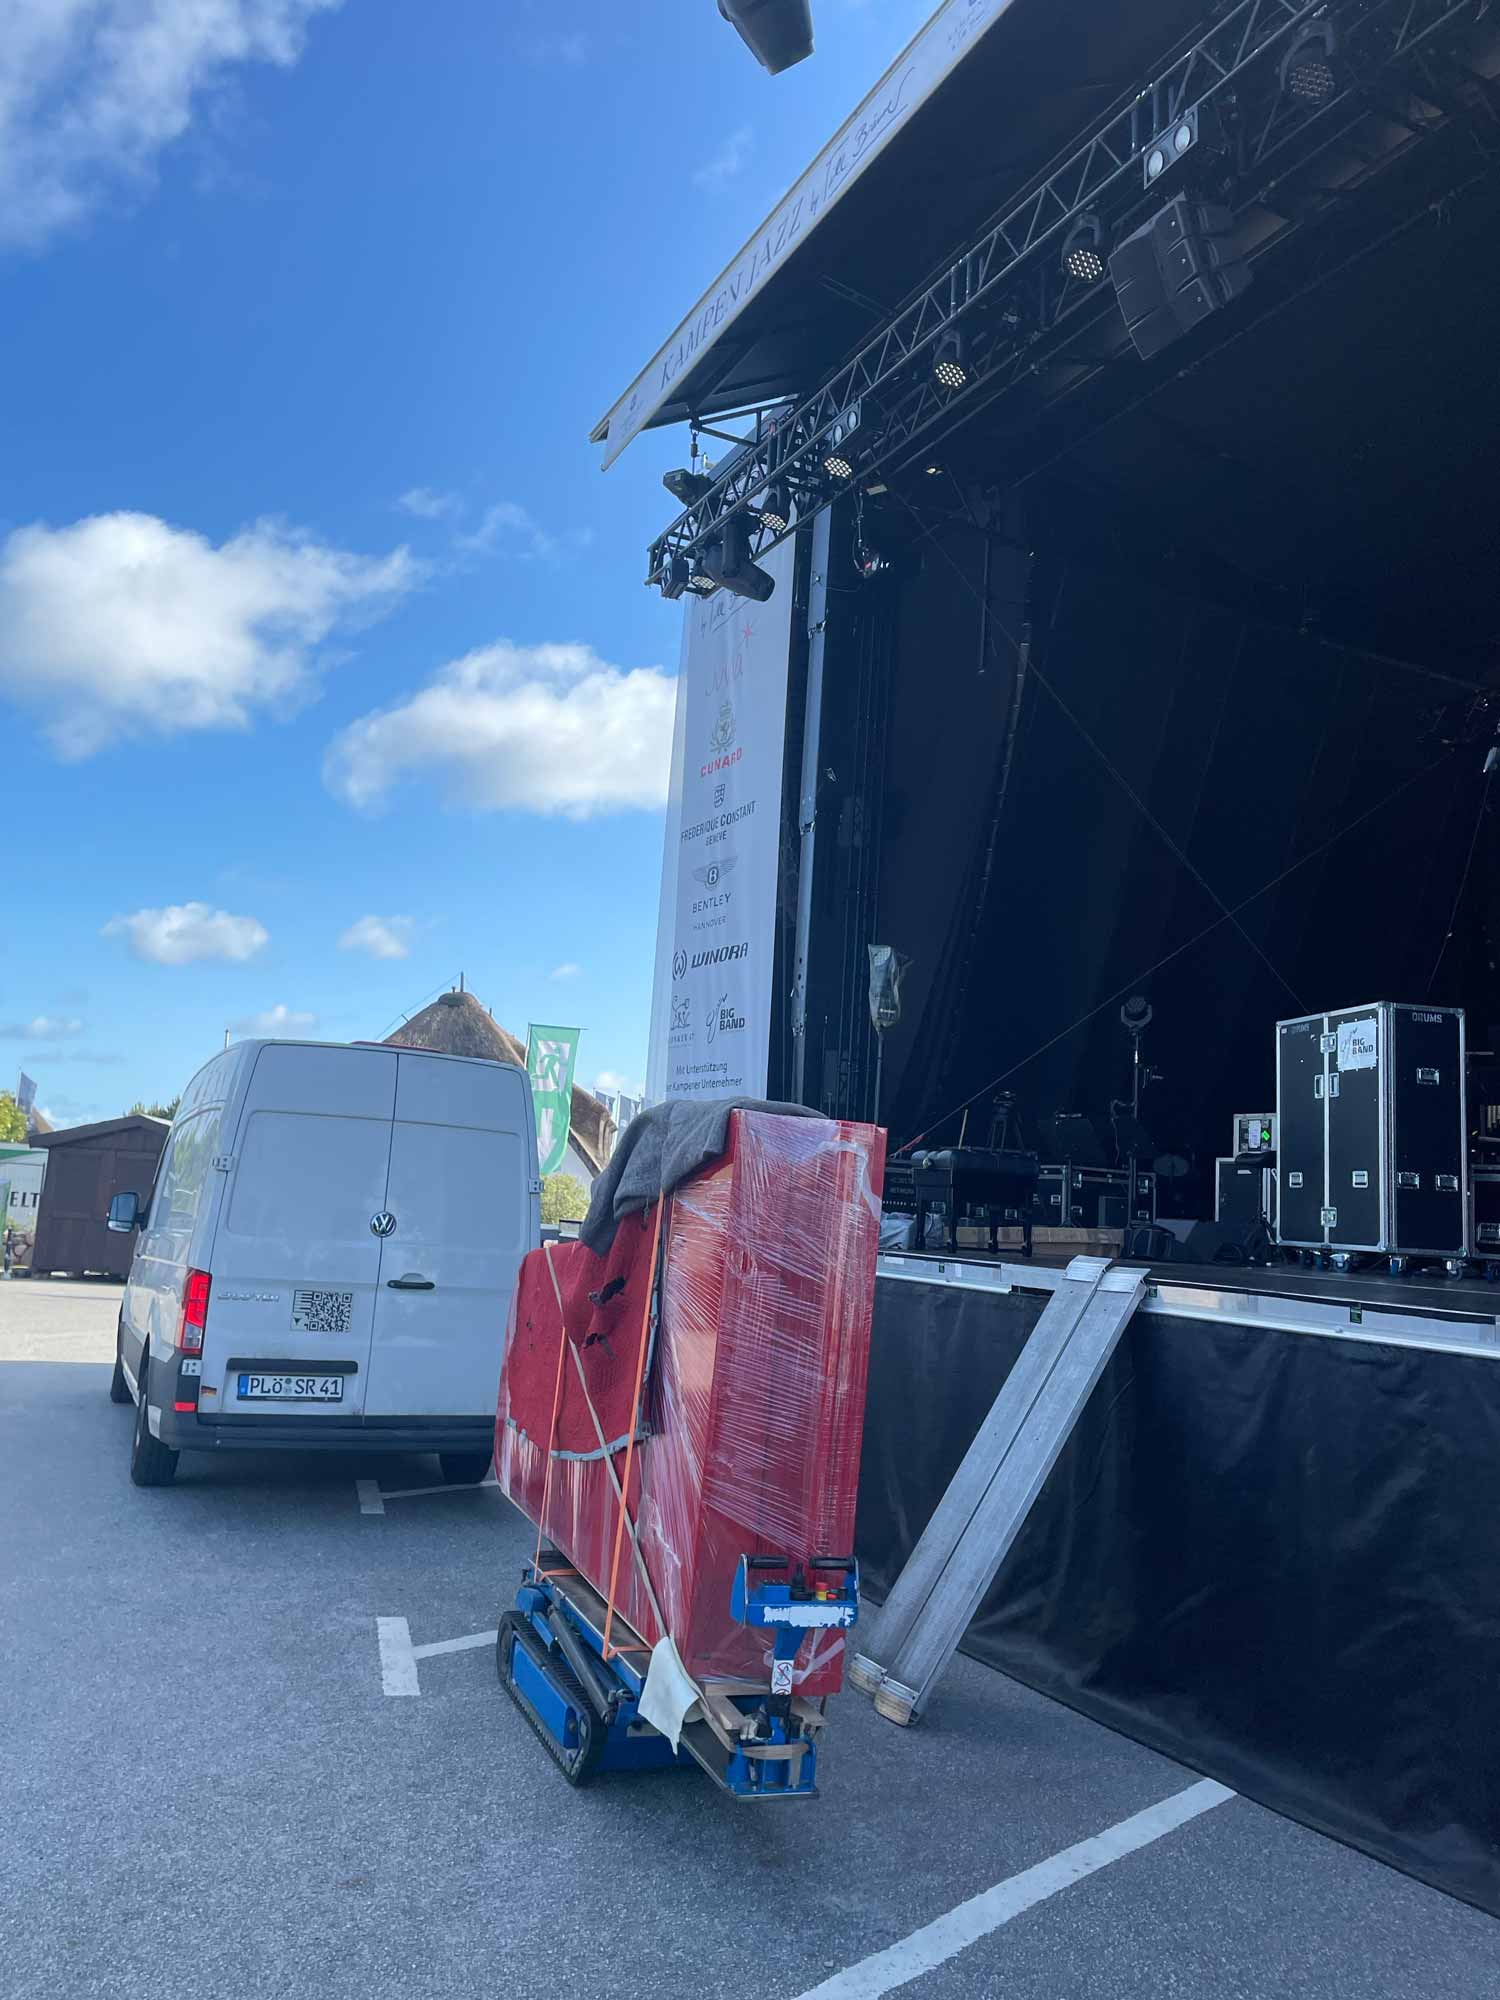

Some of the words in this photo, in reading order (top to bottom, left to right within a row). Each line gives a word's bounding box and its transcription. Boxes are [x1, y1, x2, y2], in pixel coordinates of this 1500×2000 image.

[660, 270, 744, 390] KAMPEN
[744, 197, 806, 295] JAZZ
[699, 746, 743, 778] CUNARD
[680, 816, 719, 843] FREDERIQUE
[719, 800, 757, 827] CONSTANT
[691, 892, 732, 913] BENTLEY
[690, 941, 749, 969] WINORA
[719, 1007, 736, 1019] BIG
[1411, 1012, 1443, 1024] DRUMS
[719, 1017, 746, 1031] BAND
[1291, 1023, 1310, 1035] UMS
[1352, 1037, 1365, 1047] BIG
[1352, 1044, 1374, 1055] BAND
[686, 1062, 728, 1077] Unterstützung
[702, 1075, 743, 1094] Unternehmer
[250, 1377, 283, 1394] PLÖ
[294, 1378, 316, 1395] SR
[320, 1378, 340, 1396] 41
